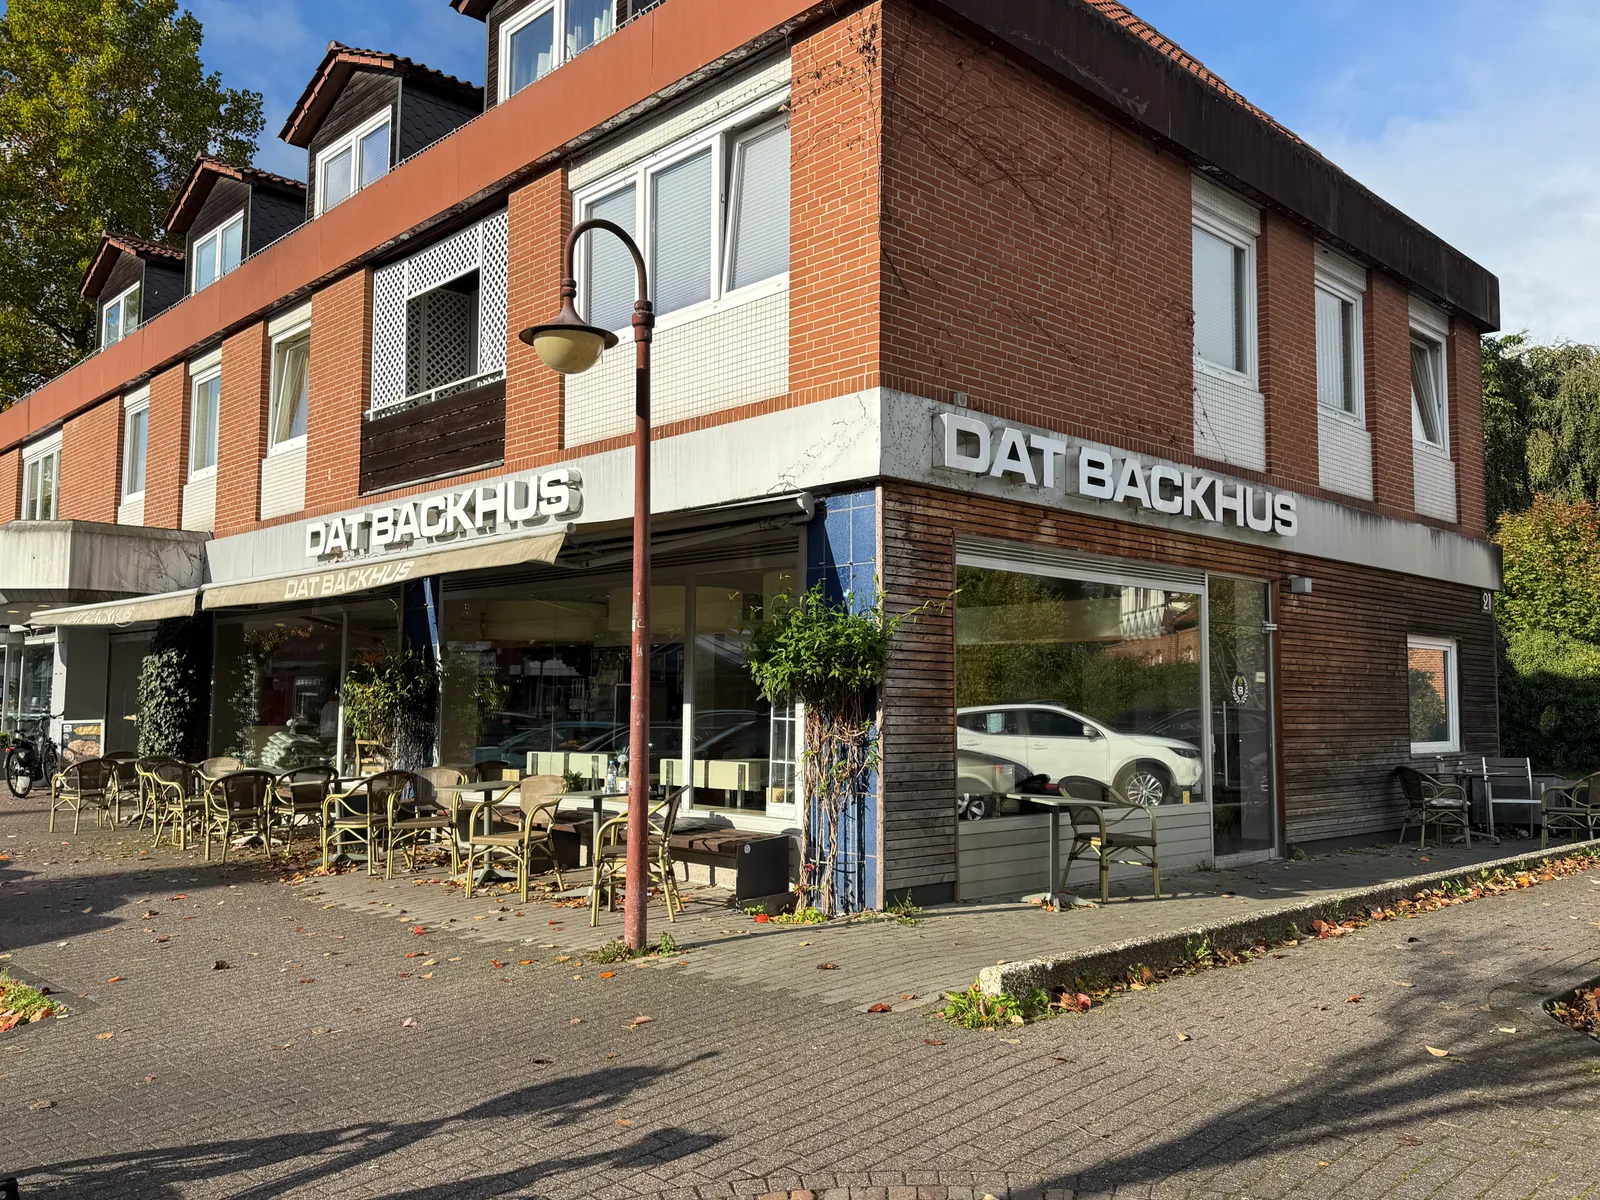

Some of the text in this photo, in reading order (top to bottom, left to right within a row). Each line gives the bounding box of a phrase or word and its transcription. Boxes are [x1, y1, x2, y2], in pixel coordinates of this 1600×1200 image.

[942, 412, 1298, 537] DAT BACKHUS
[306, 468, 573, 557] DAT BACKHUS
[284, 560, 415, 599] DAT BACKHUS
[1483, 592, 1492, 611] 21
